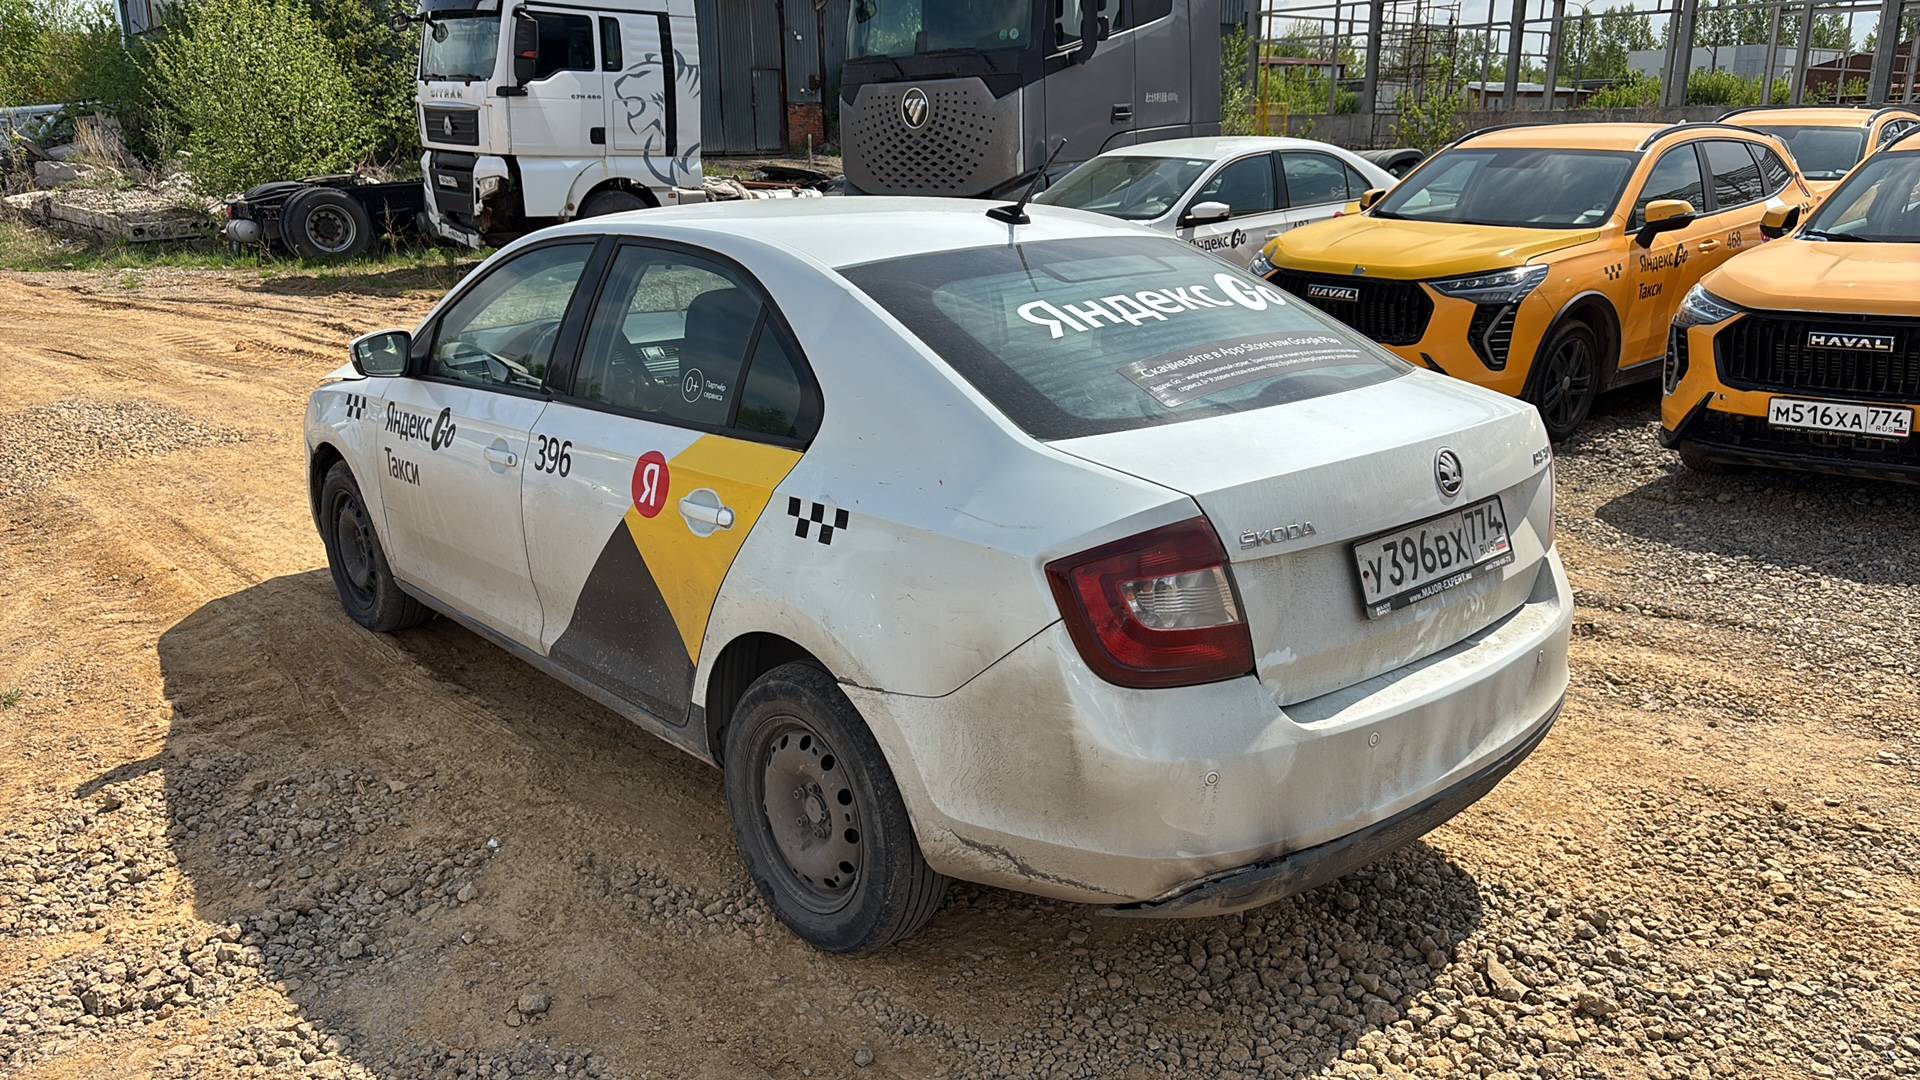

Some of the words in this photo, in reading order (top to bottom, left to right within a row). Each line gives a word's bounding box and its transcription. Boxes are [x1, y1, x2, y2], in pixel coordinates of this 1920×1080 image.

[1231, 228, 1247, 249] Go
[1727, 231, 1743, 249] 468
[1640, 252, 1674, 272] Яндекс
[1674, 243, 1688, 268] Go
[1310, 286, 1355, 299] HAVAL
[1639, 282, 1663, 300] Такси
[1017, 285, 1234, 339] Яндекс
[1214, 273, 1287, 311] Go
[1811, 335, 1889, 349] HAVAL
[1140, 353, 1213, 378] Скачивайте
[1219, 346, 1245, 356] App
[686, 376, 699, 392] 0+
[385, 401, 432, 442] Яндекс
[431, 407, 457, 451] Go
[1869, 409, 1904, 427] 774
[1875, 425, 1894, 433] RUS
[384, 447, 421, 486] Такси
[534, 434, 573, 478] 396
[639, 463, 660, 507] Я
[1240, 521, 1317, 550] ŠKODA
[1464, 504, 1501, 544] 774
[1479, 540, 1496, 556] RUS
